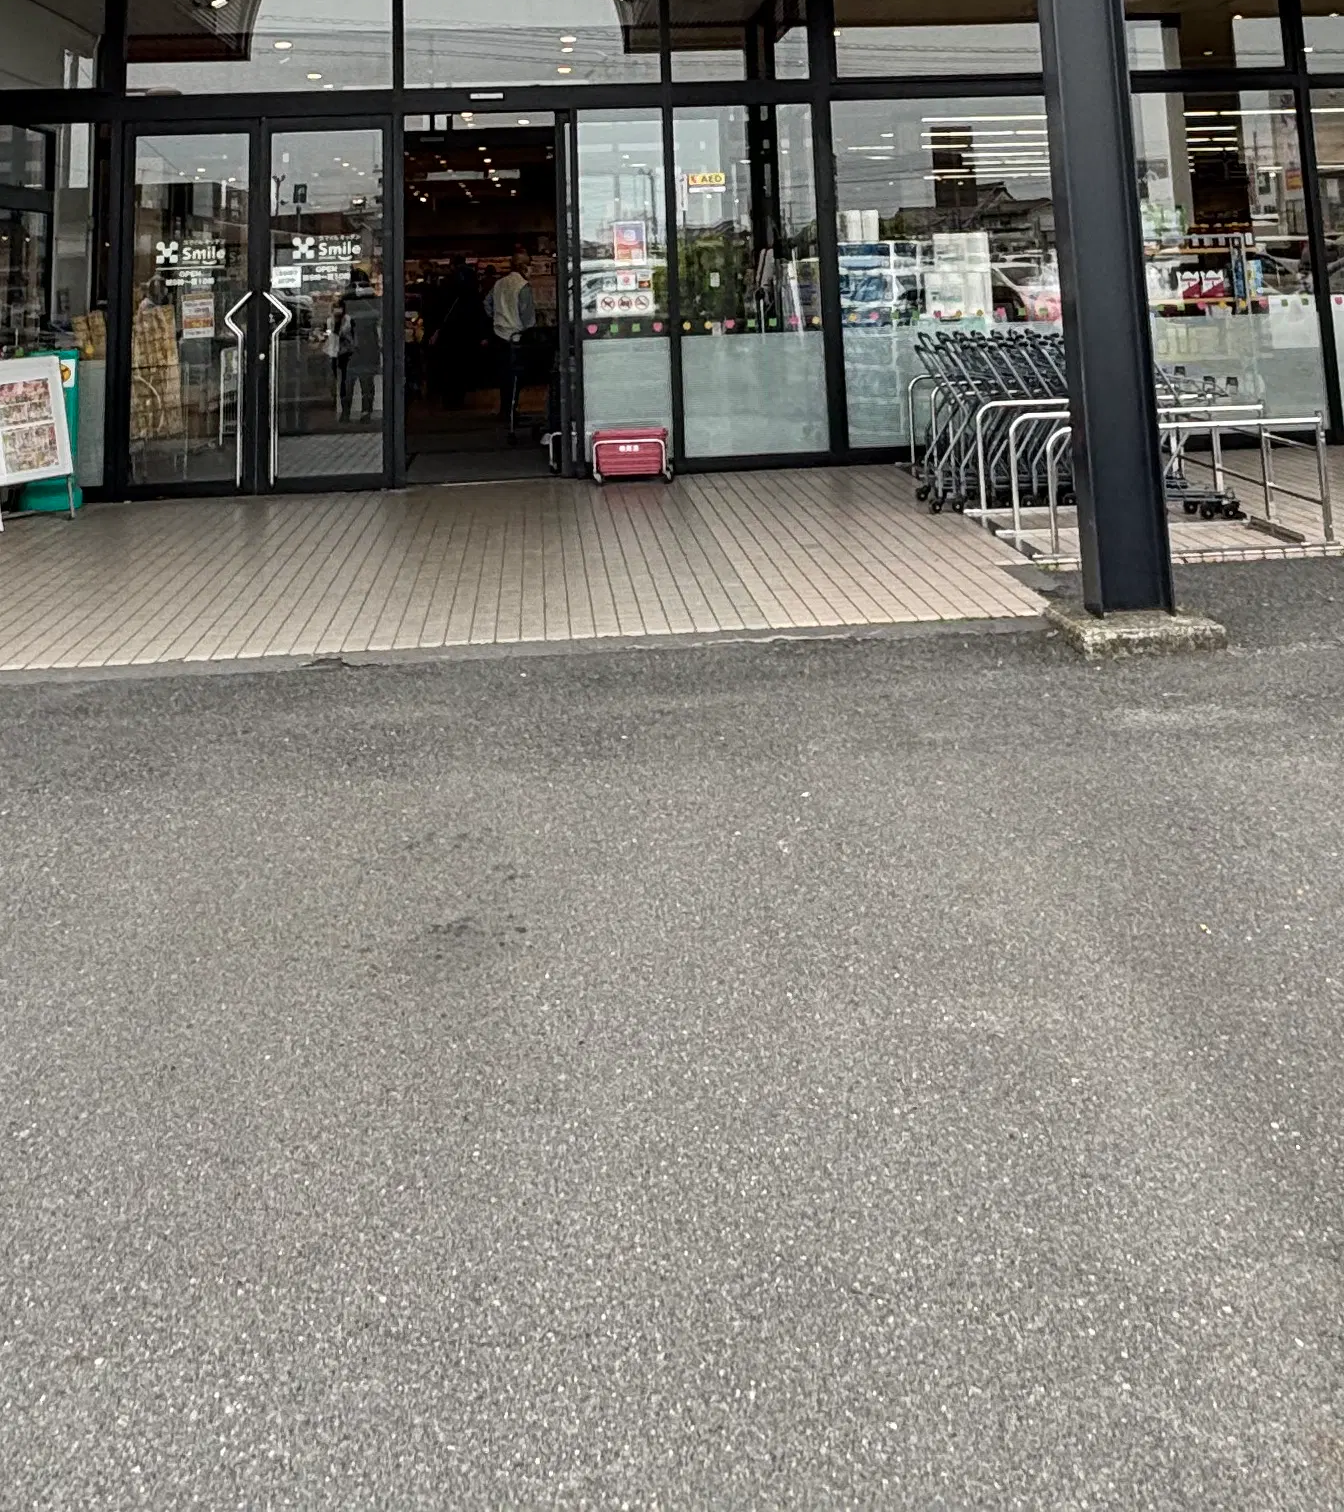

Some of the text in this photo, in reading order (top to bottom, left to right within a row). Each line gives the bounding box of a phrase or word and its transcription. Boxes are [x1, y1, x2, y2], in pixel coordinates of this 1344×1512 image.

[700, 175, 723, 184] AED
[182, 245, 226, 260] Smile
[318, 240, 361, 256] Smile
